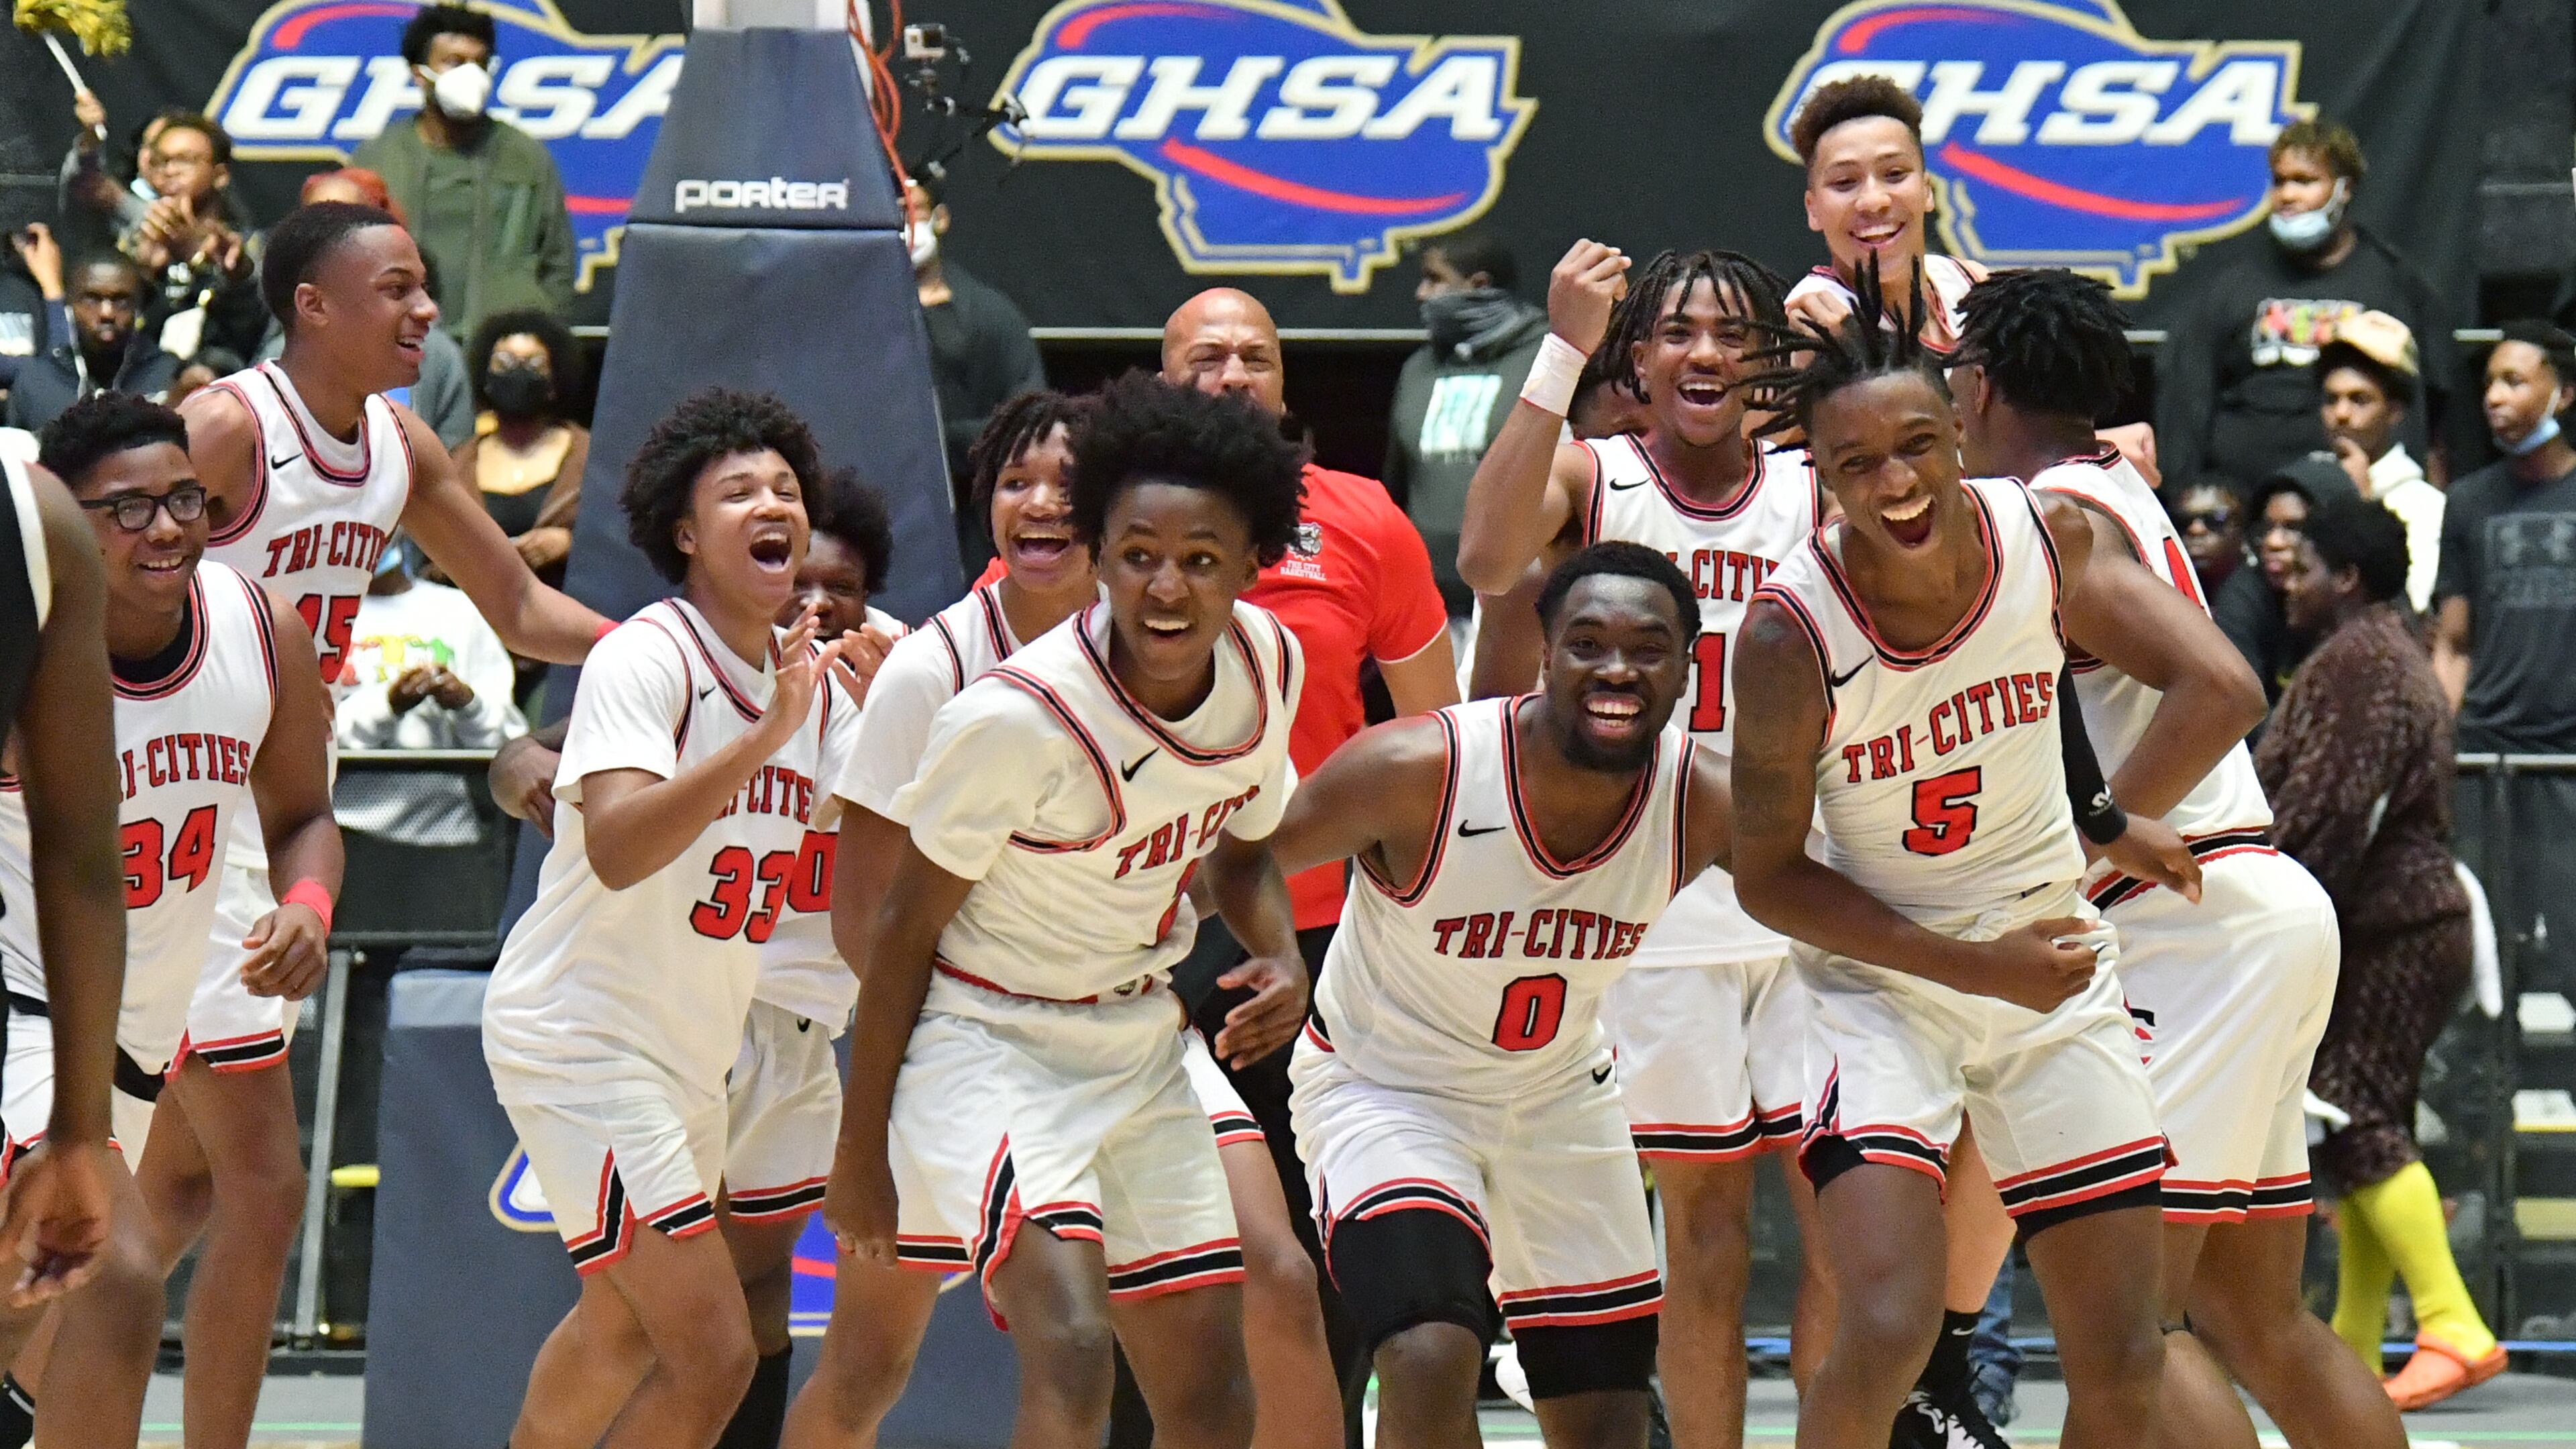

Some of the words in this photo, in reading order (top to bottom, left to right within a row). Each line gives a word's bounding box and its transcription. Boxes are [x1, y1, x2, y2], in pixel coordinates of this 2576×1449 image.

[1018, 56, 1501, 140] GHSA
[117, 733, 251, 800] I-CITIES
[1841, 672, 2053, 784] TRI-CITIES
[1901, 765, 1982, 857] 5
[119, 803, 218, 910] 34
[689, 845, 797, 944] 33
[1432, 908, 1650, 960] TRI-CITIES
[1490, 972, 1568, 1052] 0
